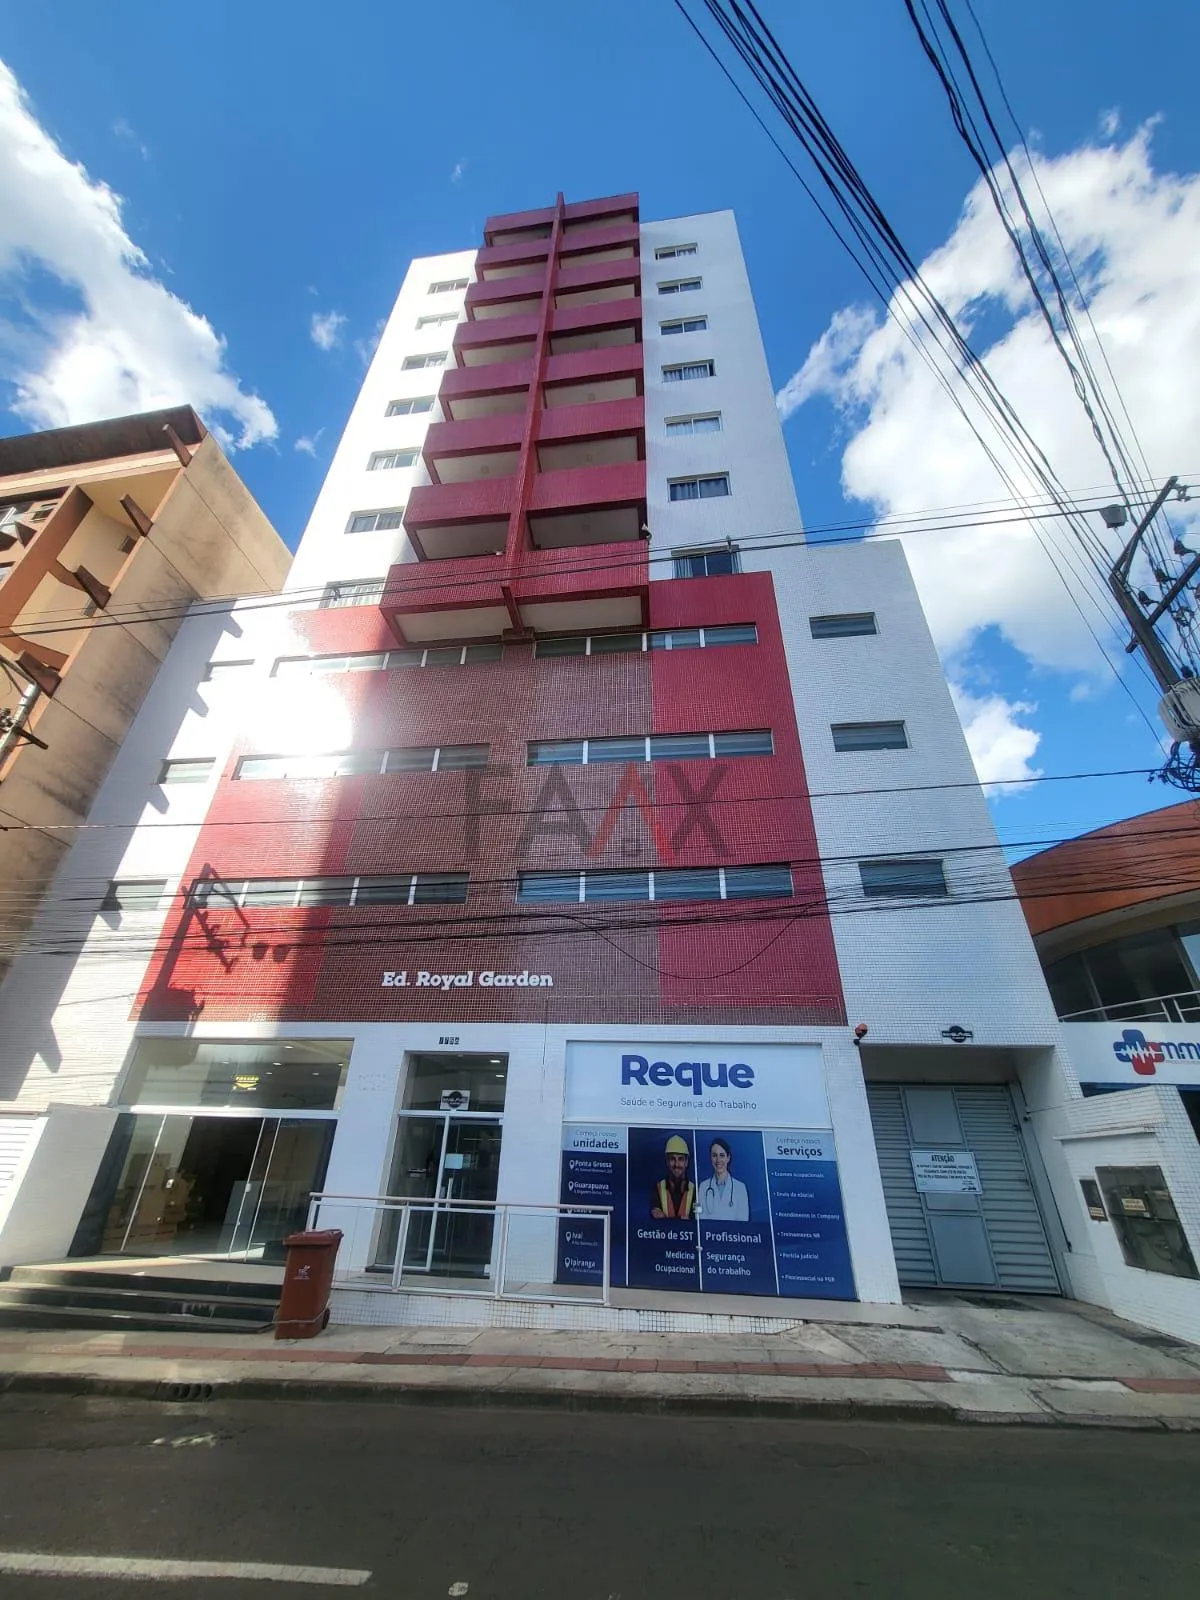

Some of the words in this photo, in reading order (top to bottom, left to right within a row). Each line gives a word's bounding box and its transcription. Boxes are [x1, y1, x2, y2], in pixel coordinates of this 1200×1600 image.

[381, 971, 411, 987] Ed.
[415, 971, 474, 990] Royal
[478, 970, 554, 987] Garden
[621, 1055, 755, 1095] Reque
[620, 1097, 648, 1107] Saúde
[656, 1099, 703, 1109] Segurança
[705, 1100, 717, 1108] do
[719, 1100, 757, 1110] Trabalho
[573, 1138, 620, 1149] unidades
[777, 1145, 823, 1159] Serviços
[931, 1153, 955, 1164] ATENÇÃO
[637, 1229, 666, 1239] Gestão
[667, 1230, 679, 1240] de
[679, 1231, 694, 1241] SST
[705, 1231, 762, 1243] Profissional
[665, 1250, 695, 1260] Medicina
[706, 1251, 745, 1262] Segurança
[655, 1264, 696, 1275] Ocupacional
[707, 1266, 717, 1274] do
[718, 1267, 751, 1276] trabalho
